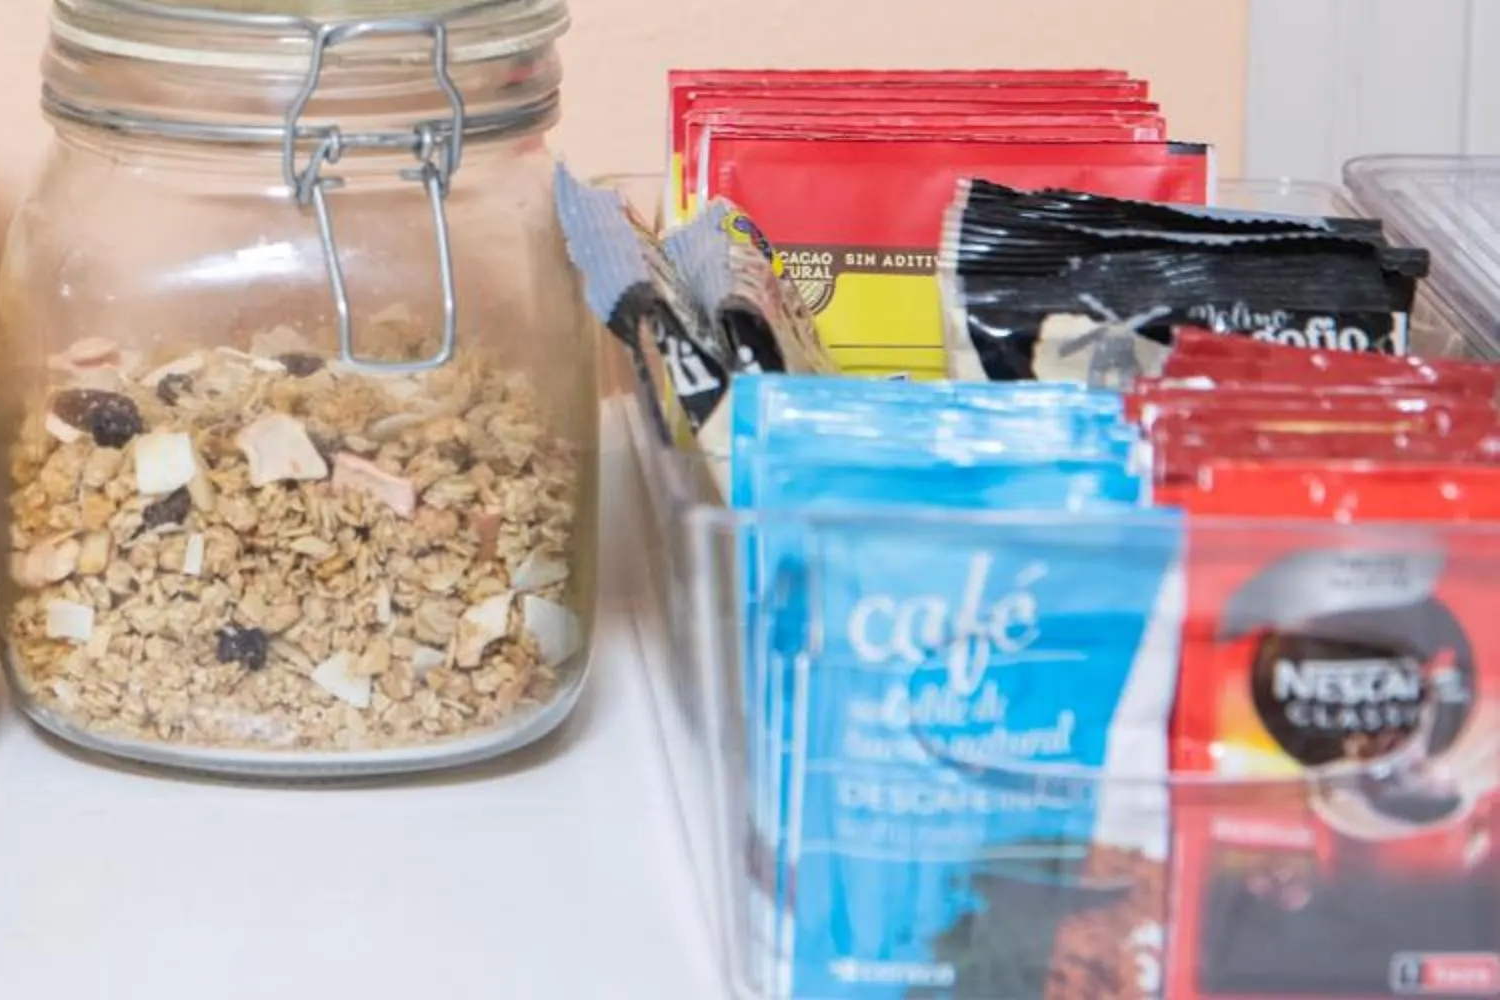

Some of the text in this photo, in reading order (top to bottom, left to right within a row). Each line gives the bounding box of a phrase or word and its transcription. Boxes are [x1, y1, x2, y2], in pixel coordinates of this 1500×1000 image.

[780, 251, 834, 265] CACAO
[844, 254, 877, 266] SIN
[847, 551, 1047, 697] café
